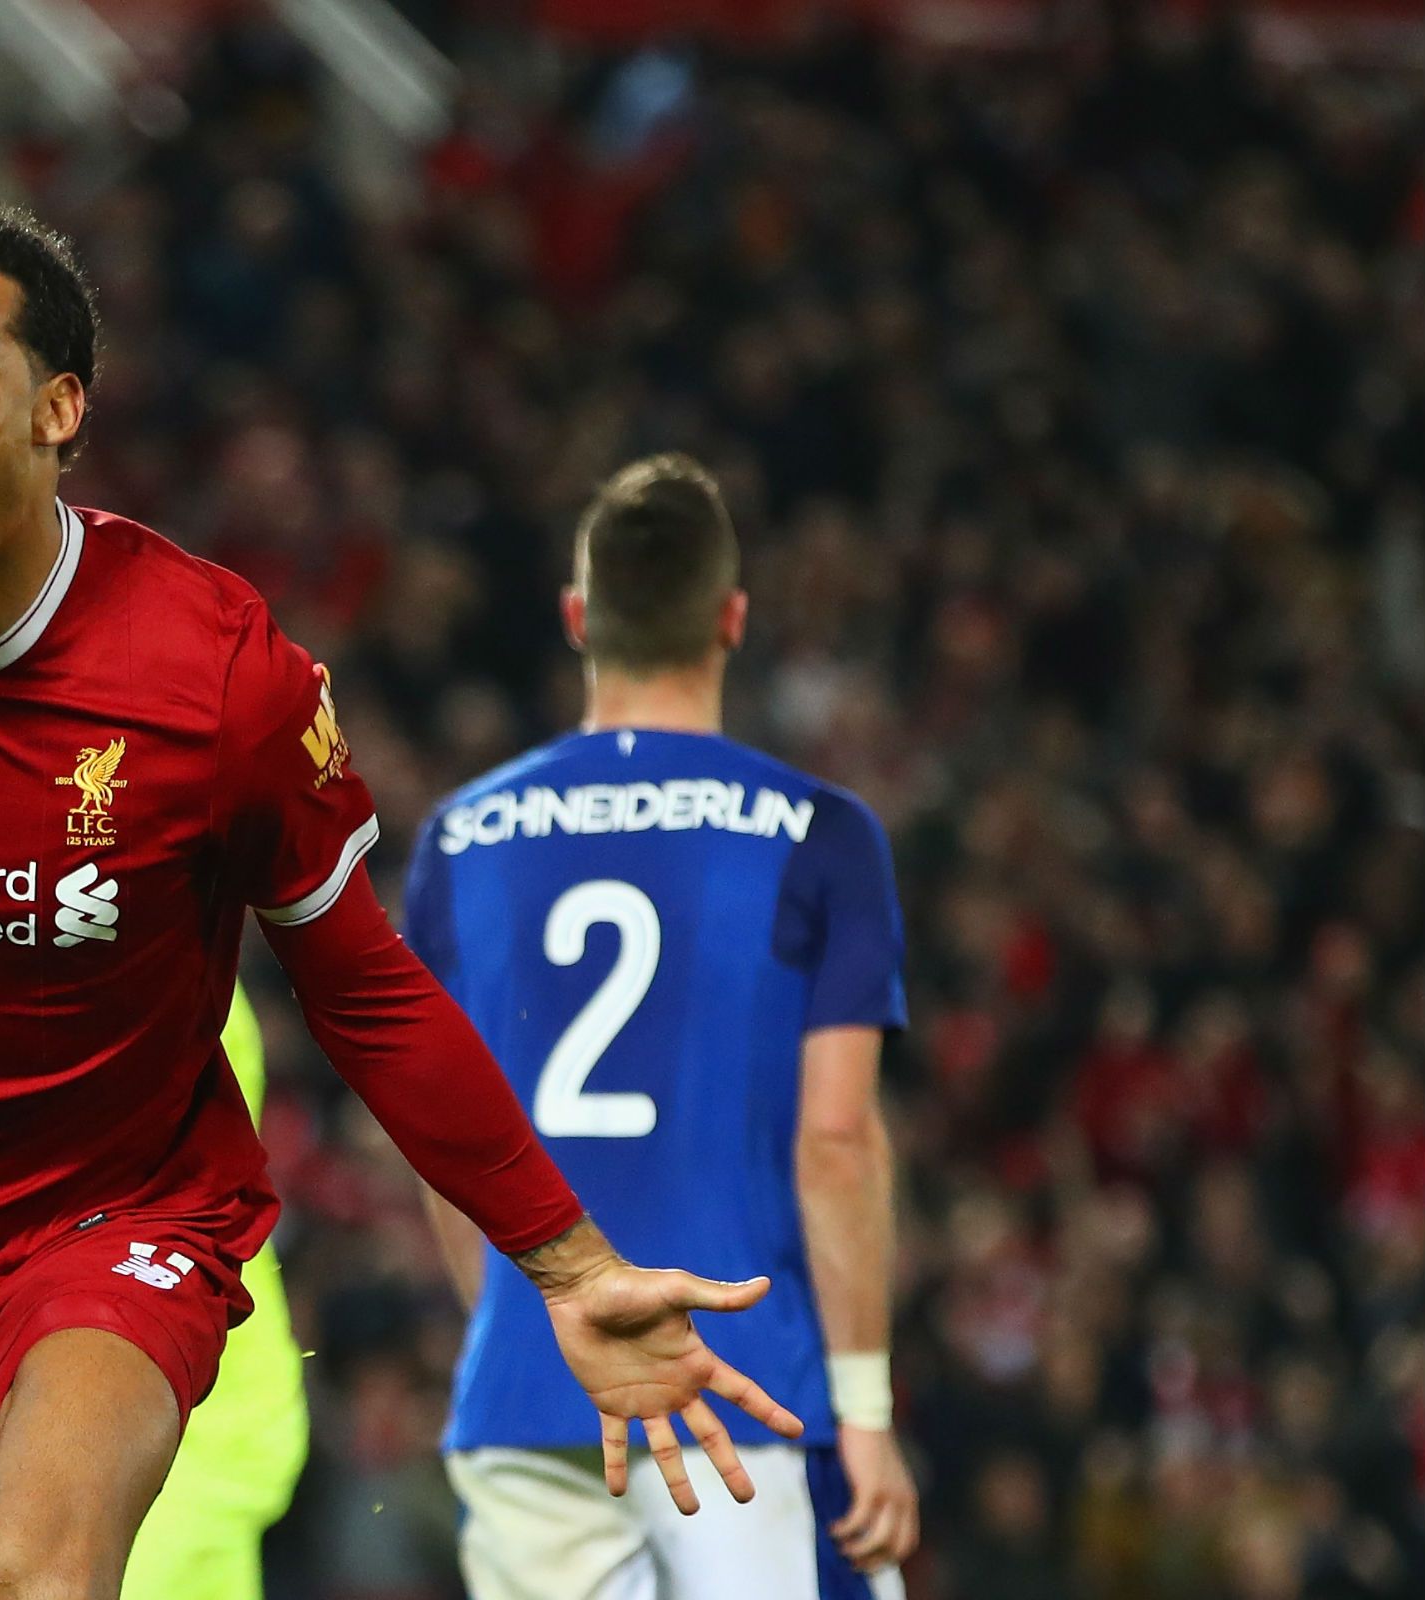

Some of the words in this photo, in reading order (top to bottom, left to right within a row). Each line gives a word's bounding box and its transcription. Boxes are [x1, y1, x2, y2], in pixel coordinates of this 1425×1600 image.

[54, 776, 74, 786] 1892
[109, 779, 128, 789] 2017
[438, 777, 815, 855] SCHNEIDERLIN
[66, 836, 82, 846] 125
[83, 836, 116, 847] YEARS
[533, 877, 662, 1138] 2
